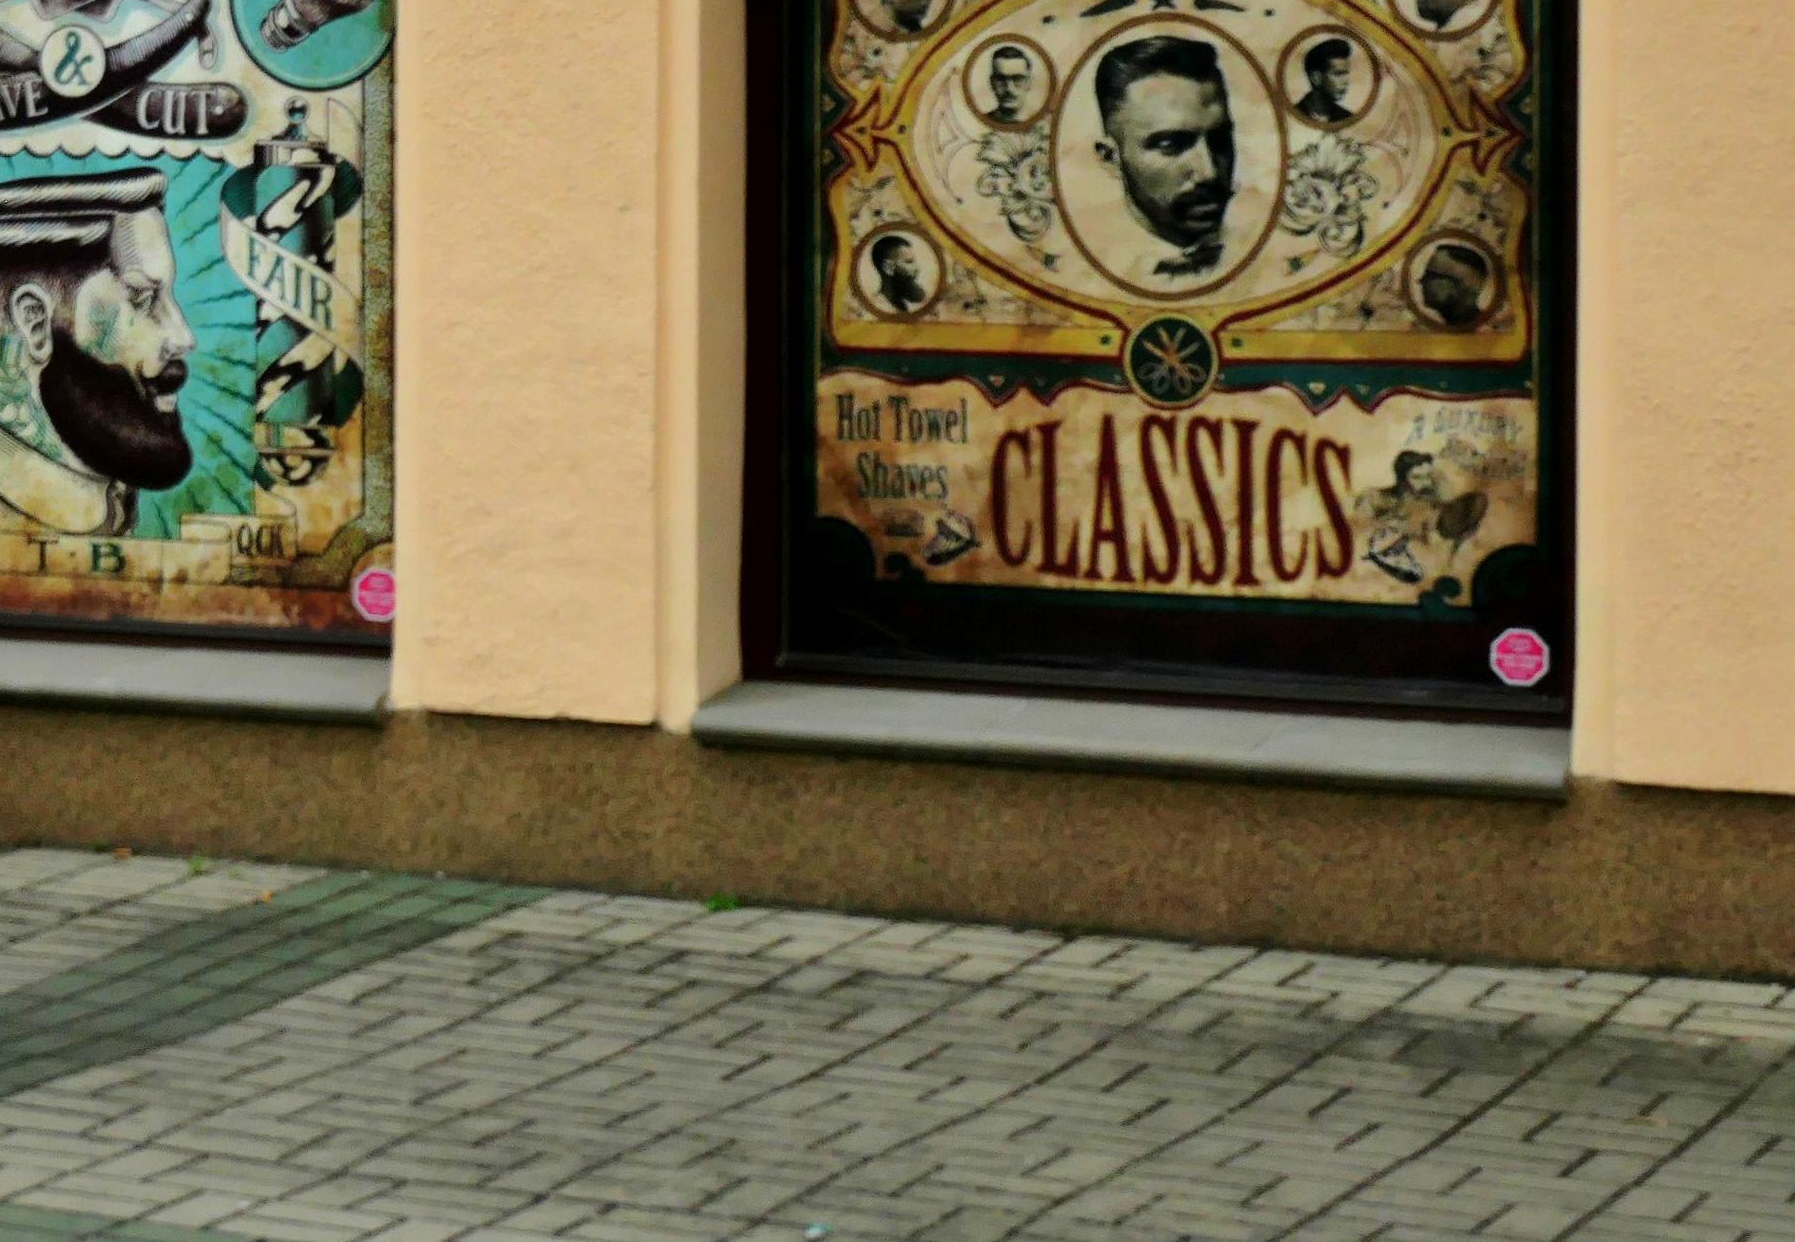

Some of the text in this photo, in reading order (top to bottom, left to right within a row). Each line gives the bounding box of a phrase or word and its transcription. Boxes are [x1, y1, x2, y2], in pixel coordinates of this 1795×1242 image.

[55, 31, 94, 86] &
[136, 88, 215, 136] CUT
[247, 235, 332, 332] FAIR
[835, 391, 968, 445] Hot Towel
[857, 451, 948, 500] Shaves
[991, 414, 1354, 586] CLASSICS
